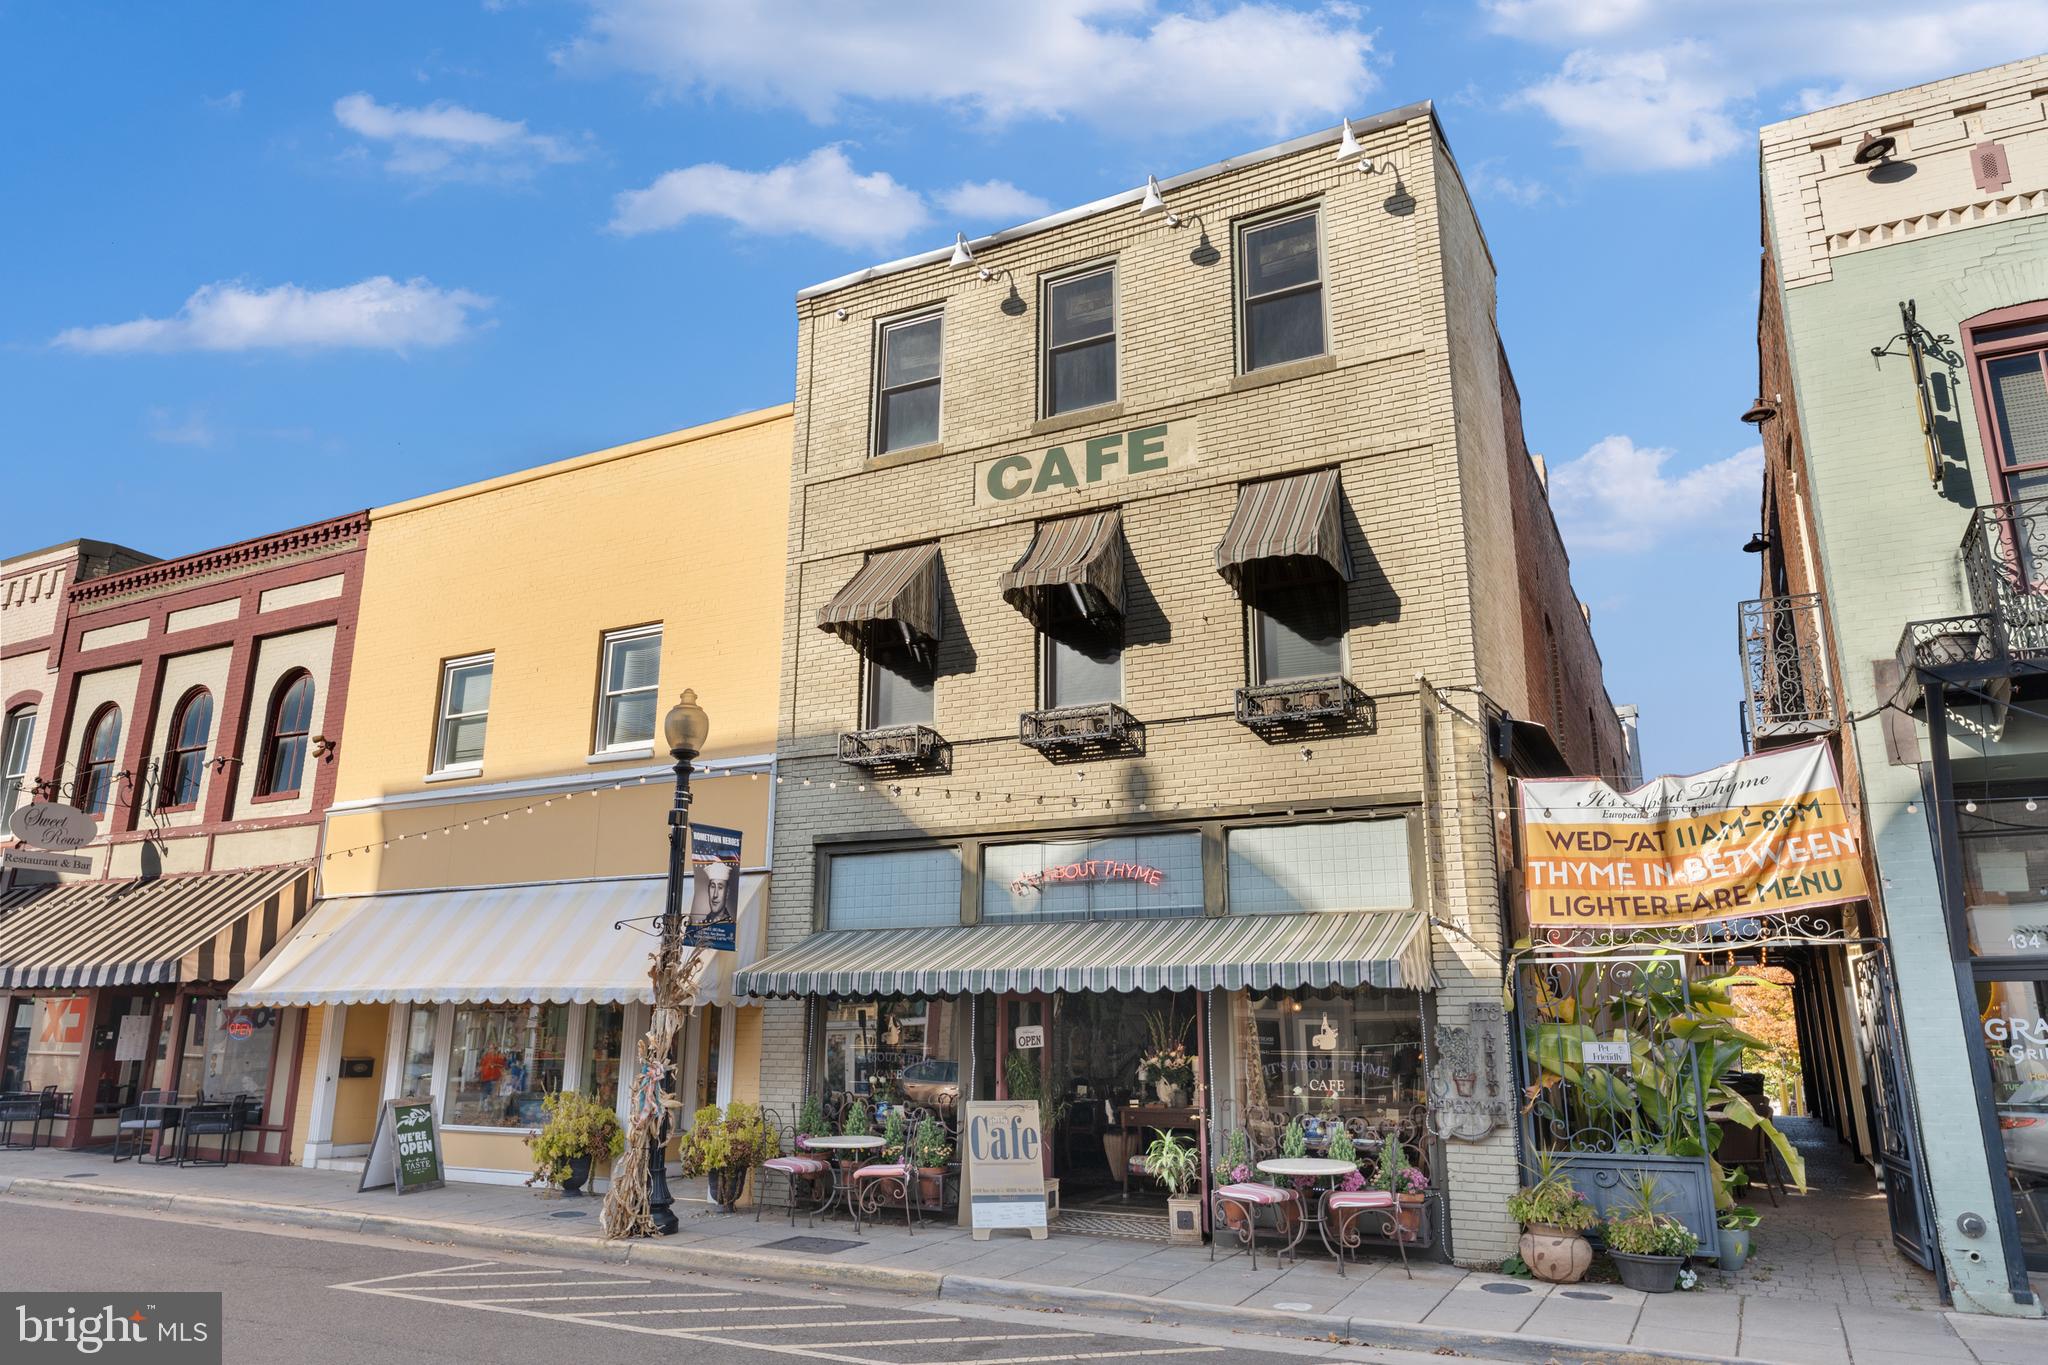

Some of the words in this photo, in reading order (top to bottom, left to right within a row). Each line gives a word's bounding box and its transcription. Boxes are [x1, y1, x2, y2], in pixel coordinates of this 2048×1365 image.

[987, 424, 1169, 500] CAFE
[1687, 775, 1770, 808] Thyme
[24, 807, 68, 830] Sweet
[41, 828, 84, 845] Roux
[4, 853, 58, 867] Restaurant
[60, 859, 70, 868] &
[73, 862, 91, 870] Bar
[1043, 860, 1100, 881] ABOUT
[1103, 860, 1164, 887] THYME
[1528, 860, 1637, 886] THYME
[1549, 894, 1669, 917] LIGHTER
[1676, 884, 1751, 916] FARE
[1755, 868, 1844, 904] MENU
[2007, 933, 2041, 950] 134
[229, 1022, 254, 1037] OPEN
[1018, 1035, 1042, 1047] OPEN
[1598, 1044, 1609, 1052] Pet
[1593, 1053, 1622, 1061] Friendly
[1990, 1048, 2006, 1057] TO
[1291, 1058, 1336, 1073] ABOUT
[1339, 1060, 1391, 1078] THYME
[1309, 1079, 1346, 1092] CAFE
[398, 1131, 427, 1143] WE'RE
[970, 1115, 1039, 1161] Cafe
[400, 1140, 433, 1157] OPEN
[404, 1160, 432, 1171] TASTE
